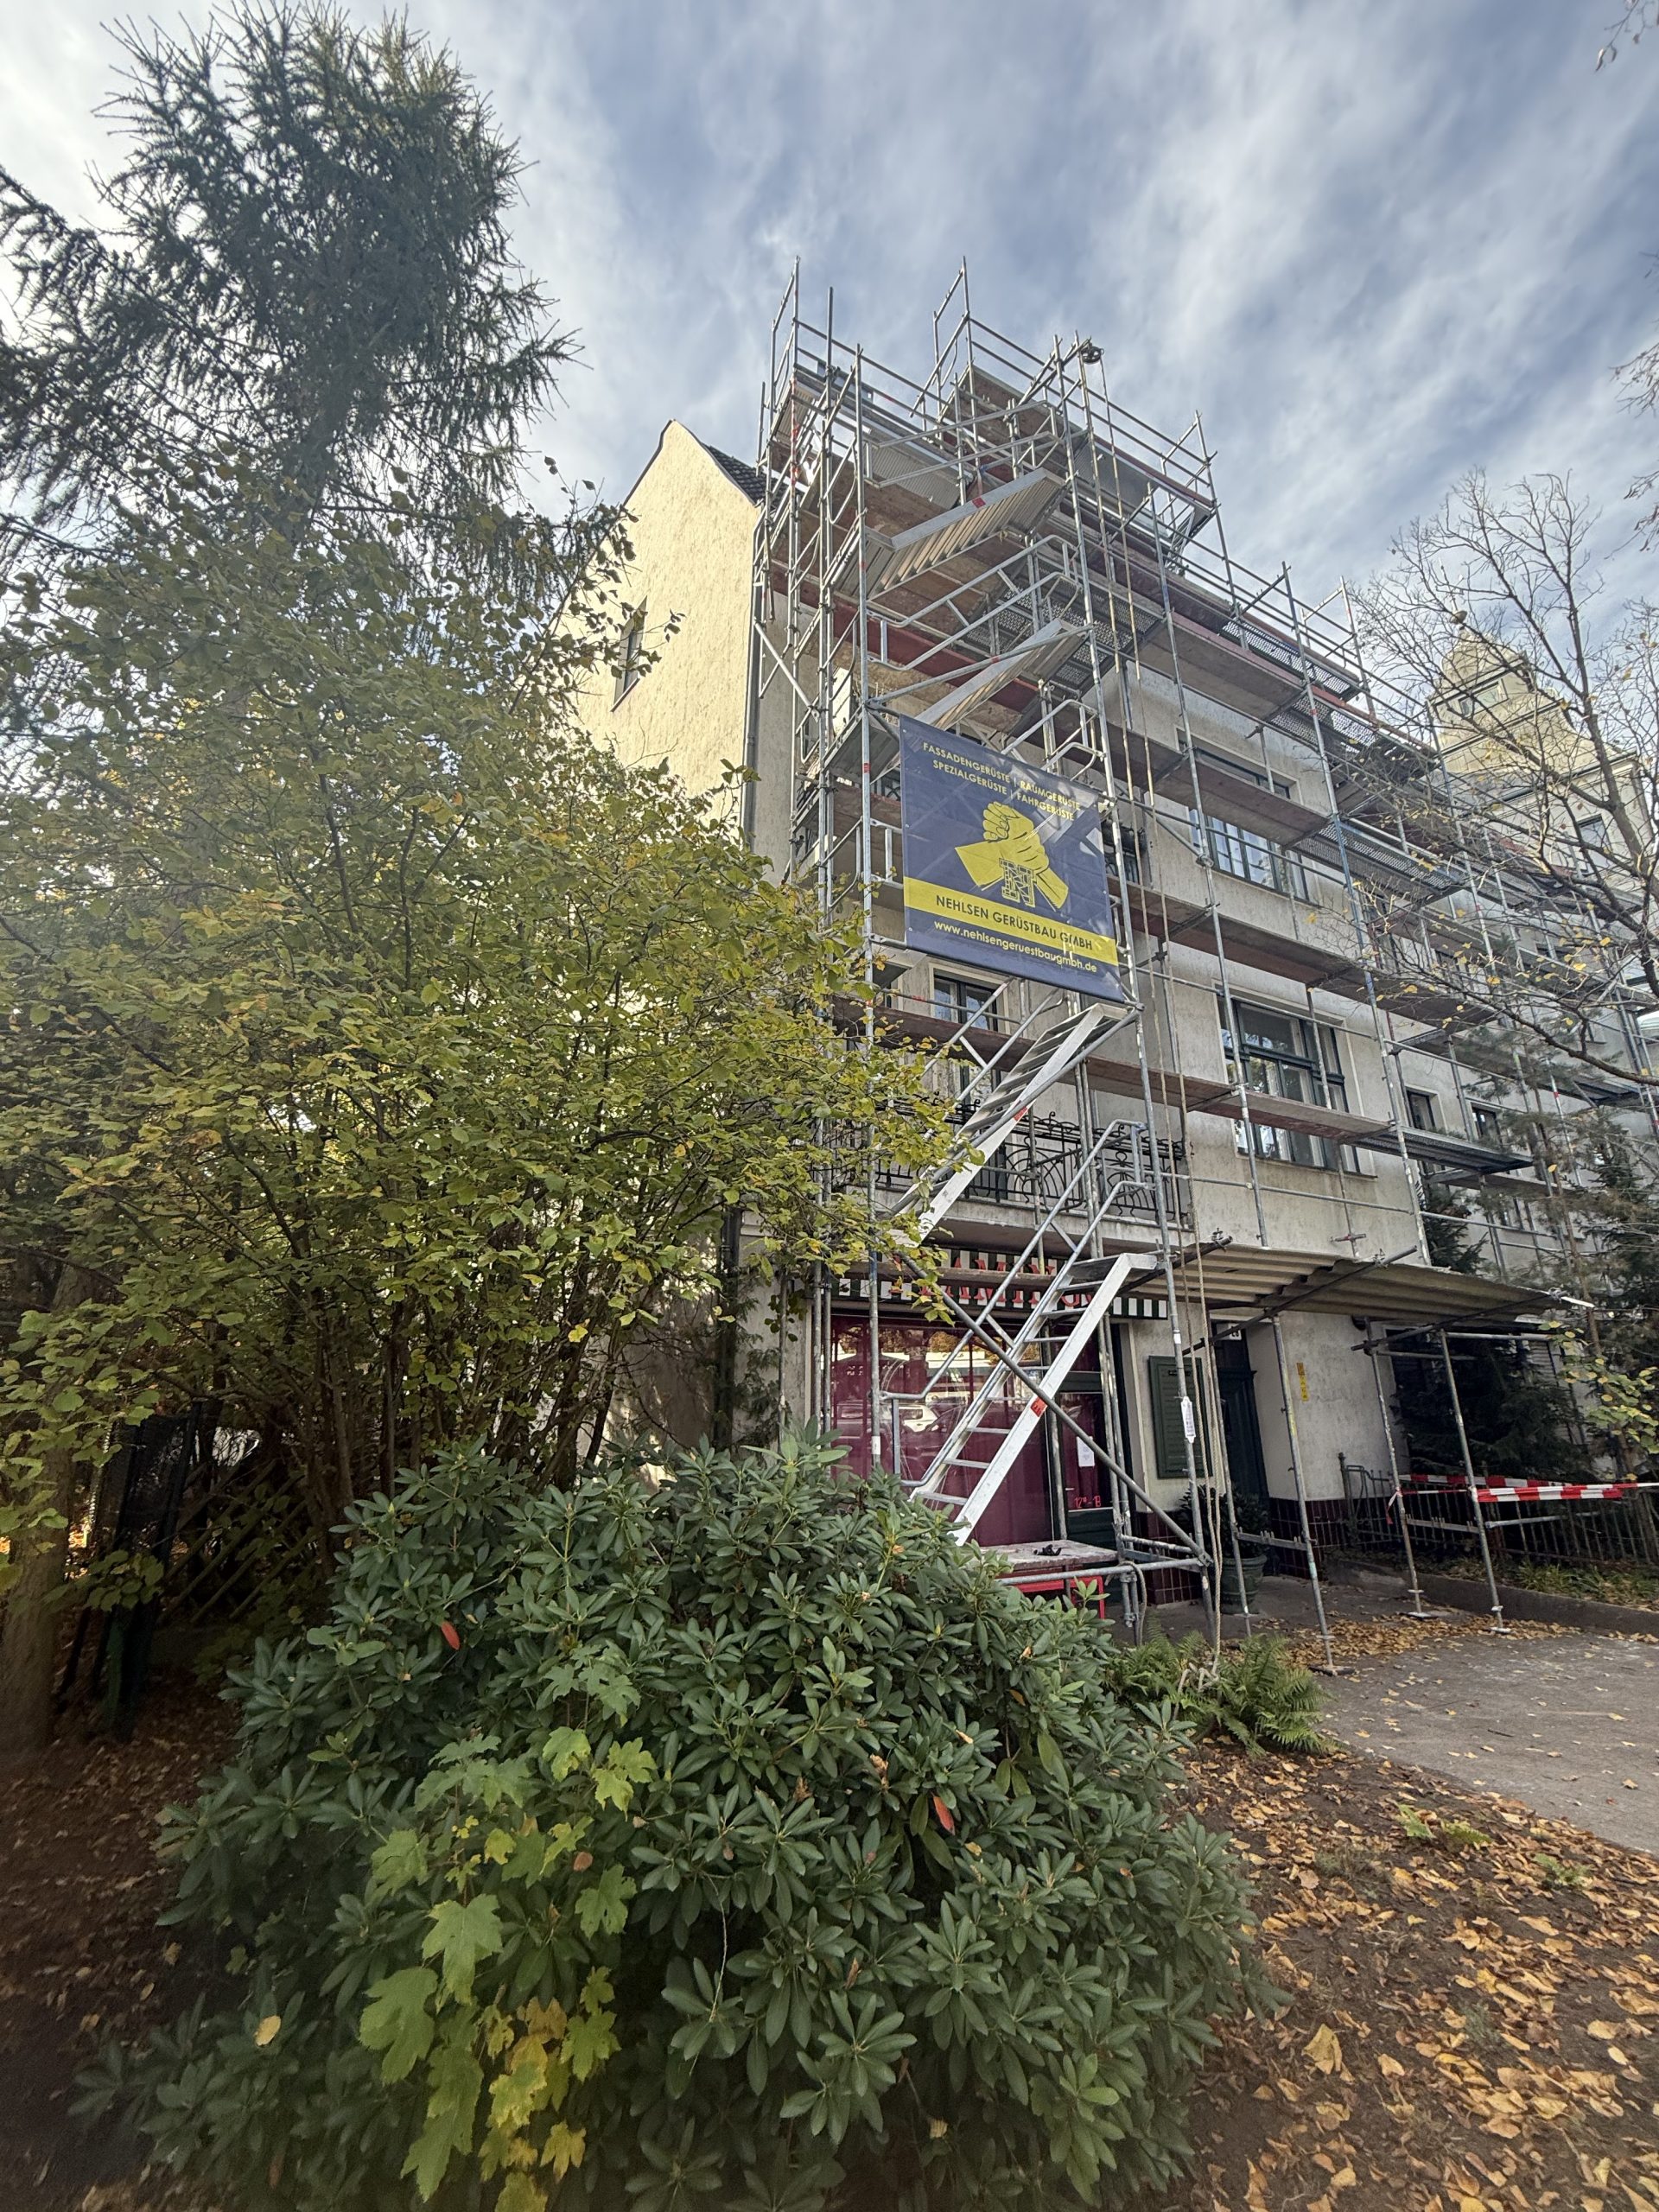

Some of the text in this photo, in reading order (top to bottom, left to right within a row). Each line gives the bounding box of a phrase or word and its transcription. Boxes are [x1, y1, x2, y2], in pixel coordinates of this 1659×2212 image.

[923, 741, 1010, 784] FASSADENGERÜSTE
[933, 760, 1075, 821] SPEZIALGERÜSTE FAHRGERÜSTE
[934, 920, 1097, 973] www.nehlsengeruestbaugmbh.de
[936, 894, 1093, 950] NEHLSEN GERÜSTBAU GMBH
